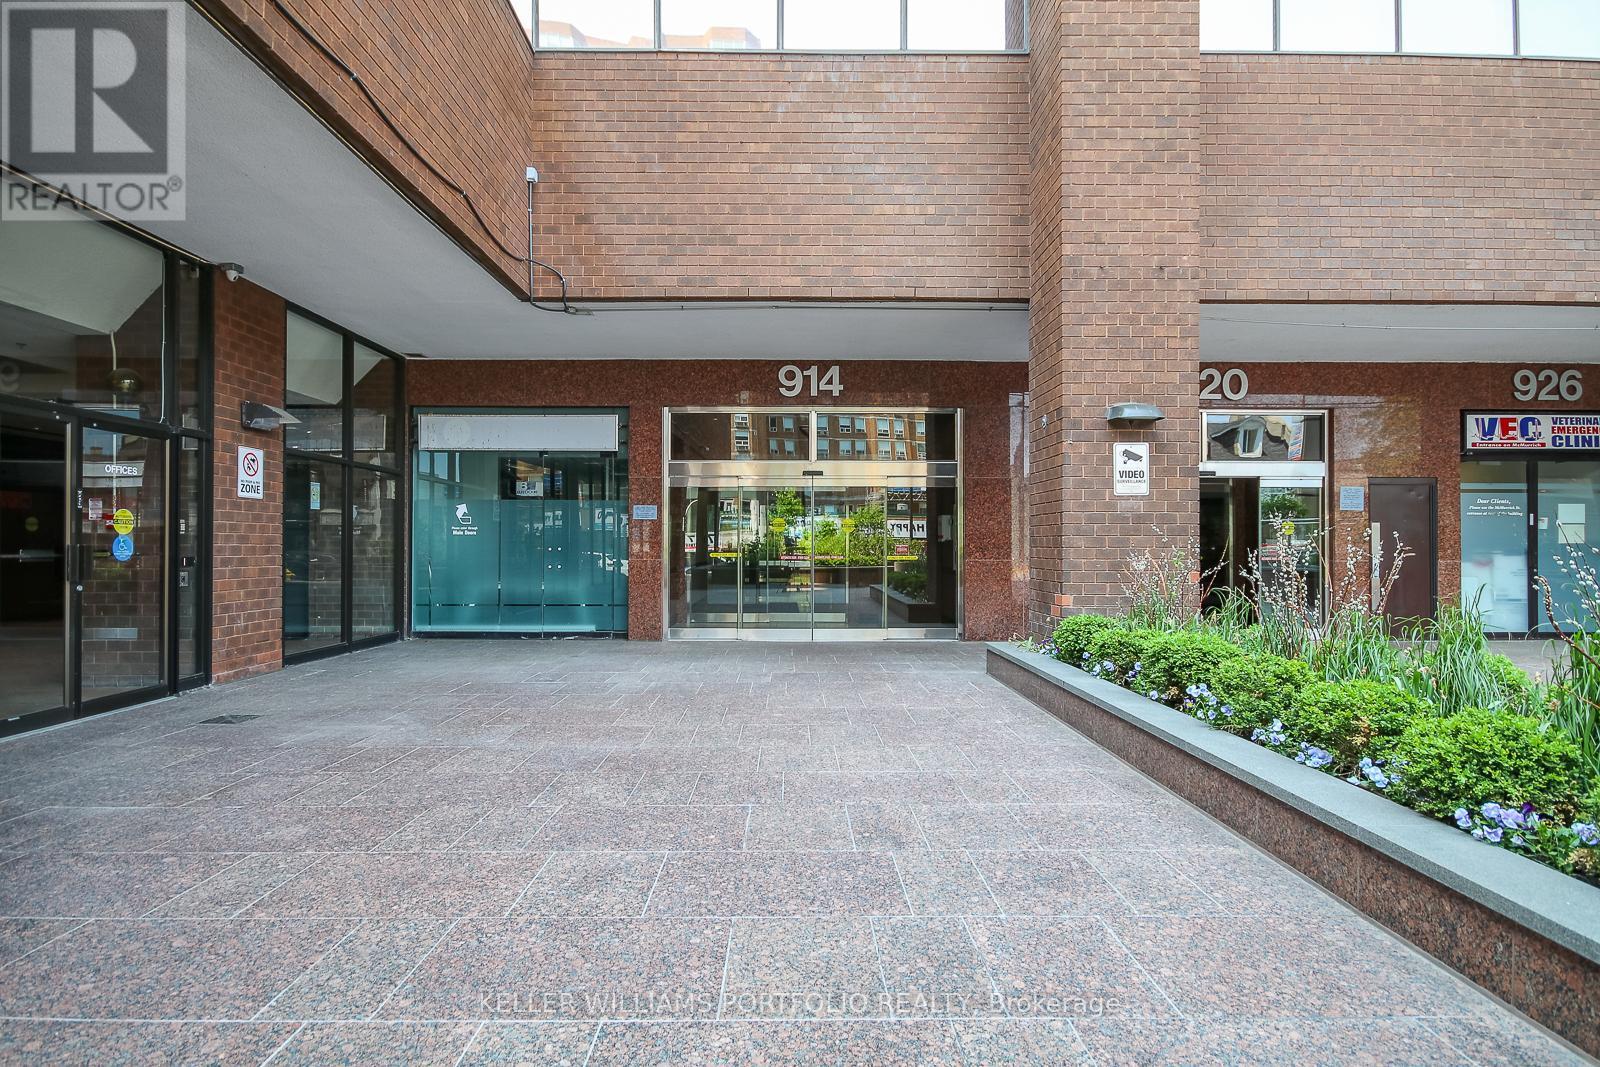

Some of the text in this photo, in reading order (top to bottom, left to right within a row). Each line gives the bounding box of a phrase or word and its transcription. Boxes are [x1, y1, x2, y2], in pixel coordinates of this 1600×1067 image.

[778, 364, 844, 397] 914
[1513, 369, 1583, 401] 926
[1474, 416, 1543, 442] VEC
[1551, 426, 1600, 434] EMERGEN
[105, 464, 138, 475] OFFICES
[1118, 470, 1145, 479] VIDEO
[240, 483, 261, 494] ZONE
